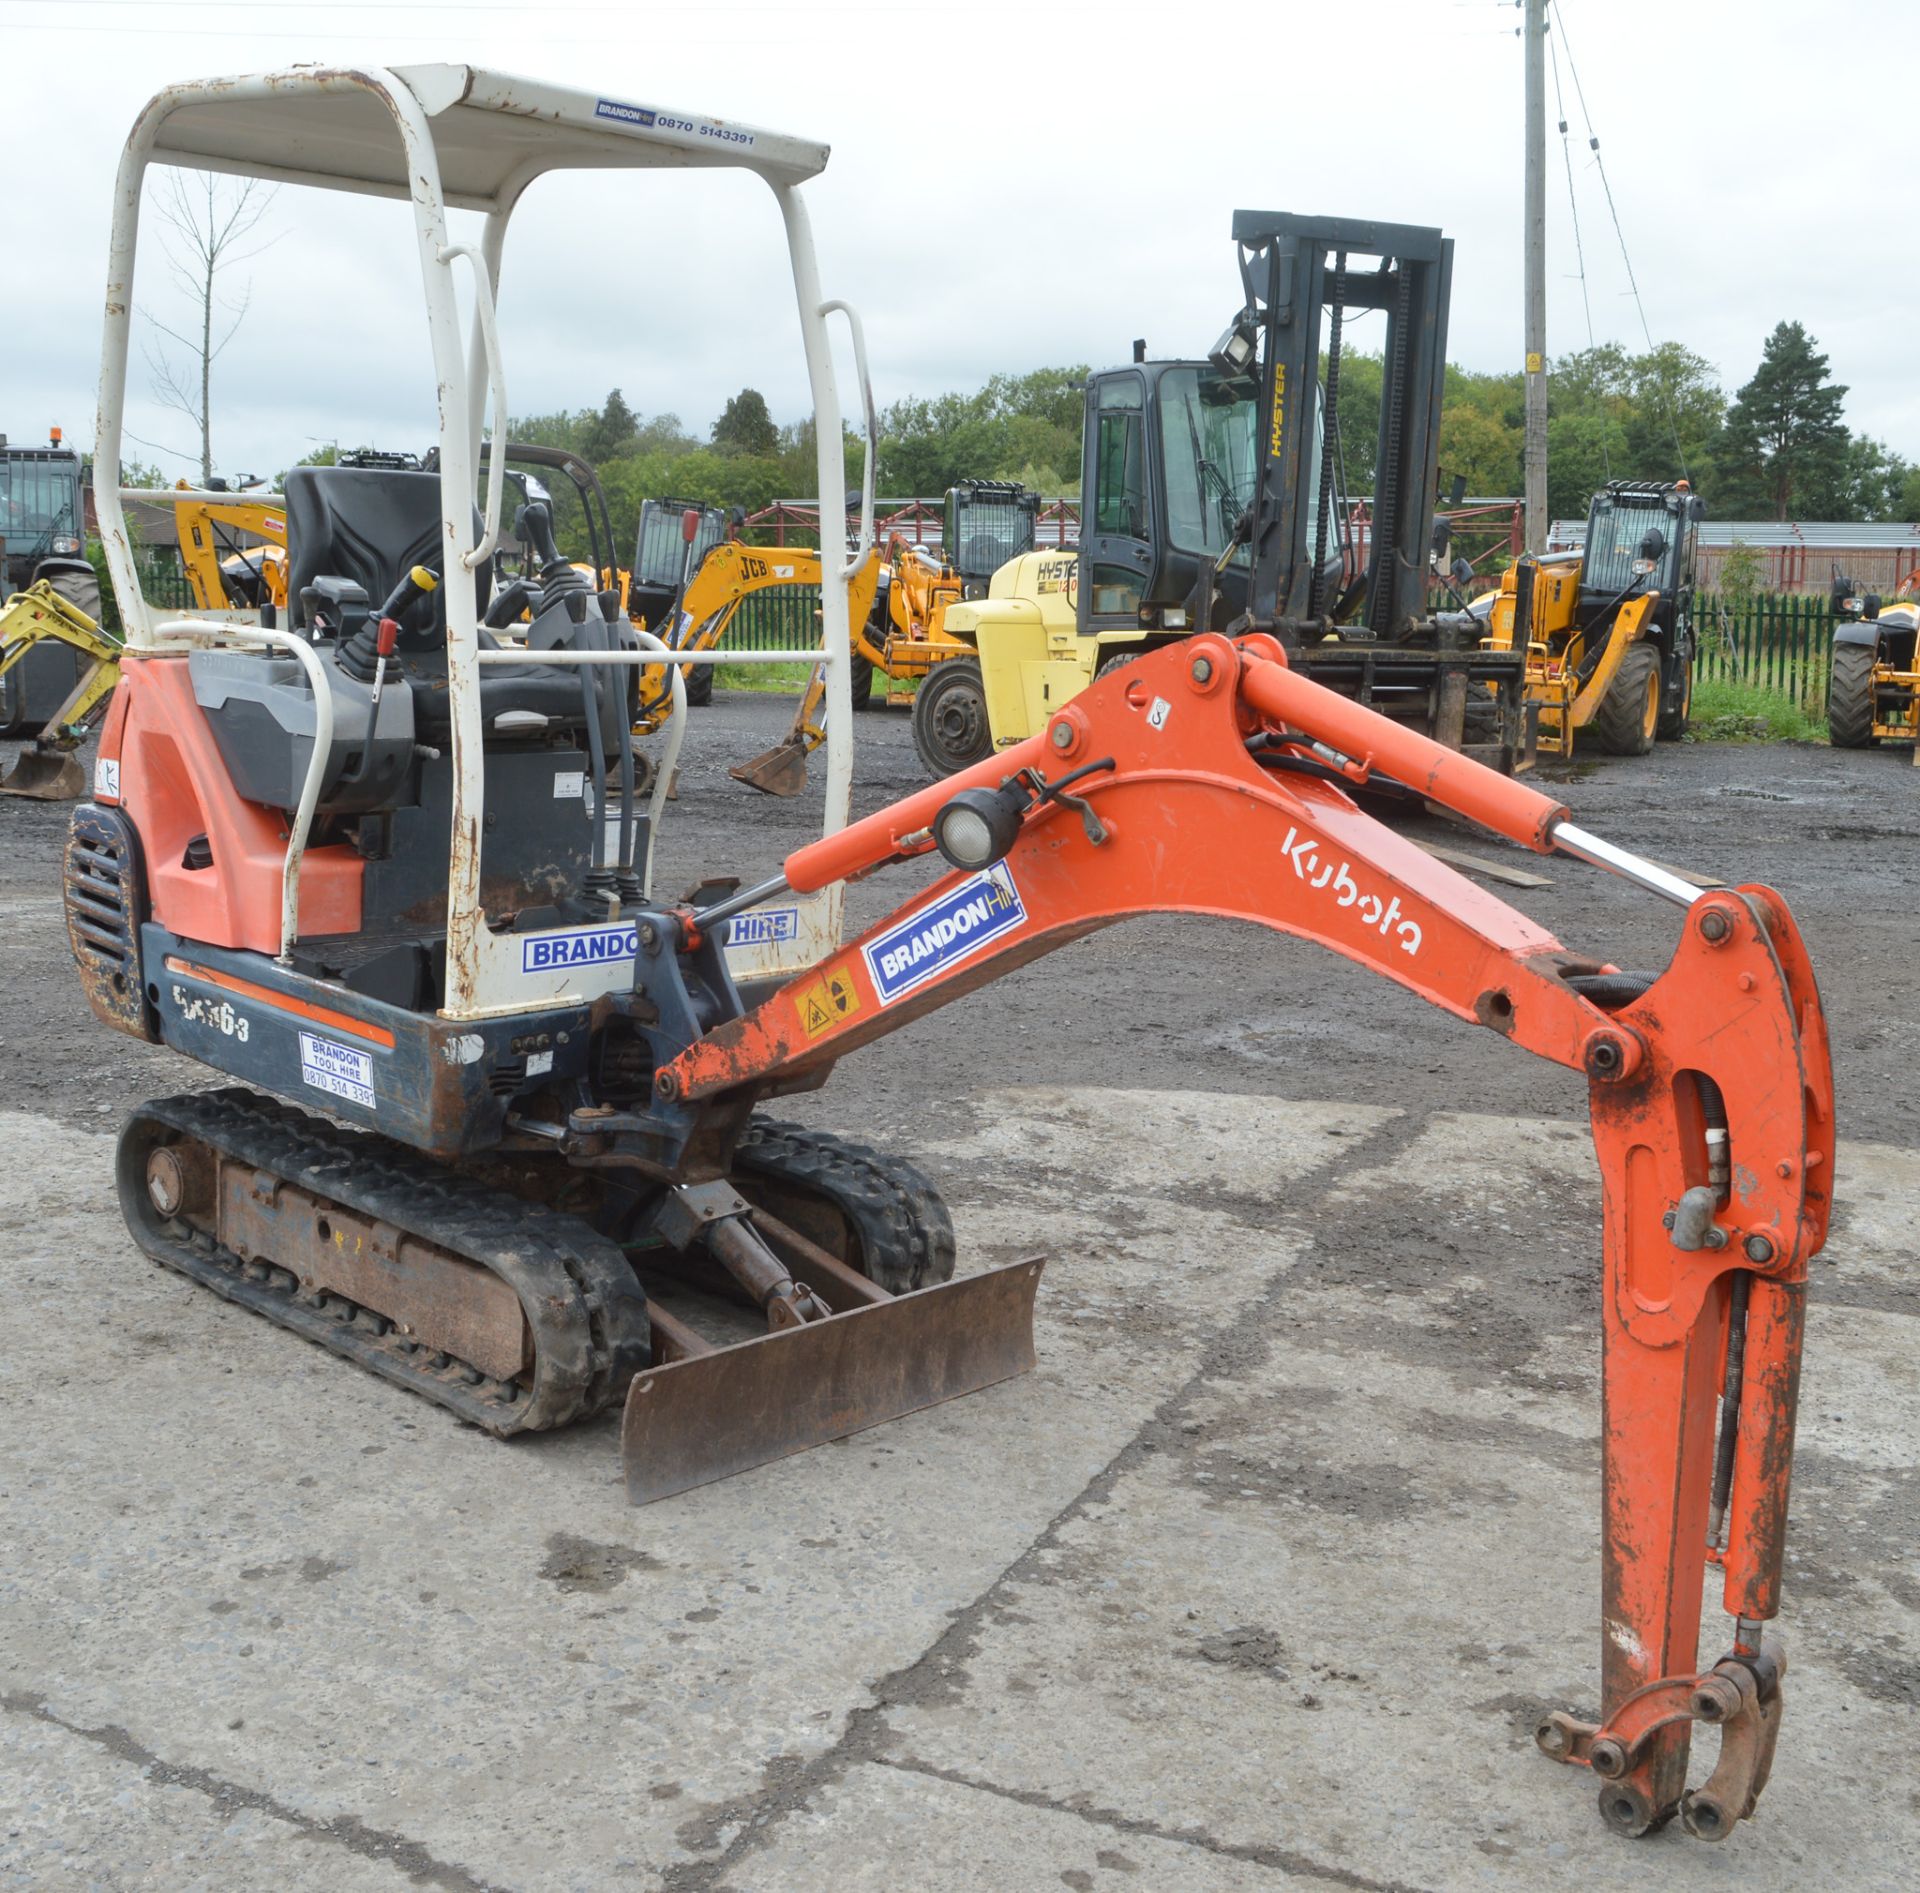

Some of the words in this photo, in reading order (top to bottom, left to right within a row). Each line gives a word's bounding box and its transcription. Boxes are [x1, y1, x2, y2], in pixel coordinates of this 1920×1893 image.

[599, 104, 641, 120] BRANDON
[658, 117, 693, 132] 0870
[700, 126, 754, 145] 5143391
[1271, 363, 1285, 457] HYSTER
[740, 556, 768, 581] JCB
[1037, 560, 1078, 580] HYSTE
[1281, 826, 1422, 956] Kubota
[533, 933, 638, 966] BRANDO
[735, 915, 788, 941] HIRE
[880, 897, 989, 980] BRANDON
[312, 1041, 360, 1068] BRANDON
[314, 1055, 337, 1072] TOOL
[340, 1065, 361, 1080] HIRE
[304, 1068, 327, 1088] 0870
[332, 1078, 348, 1096] 514
[352, 1086, 376, 1108] 3391
